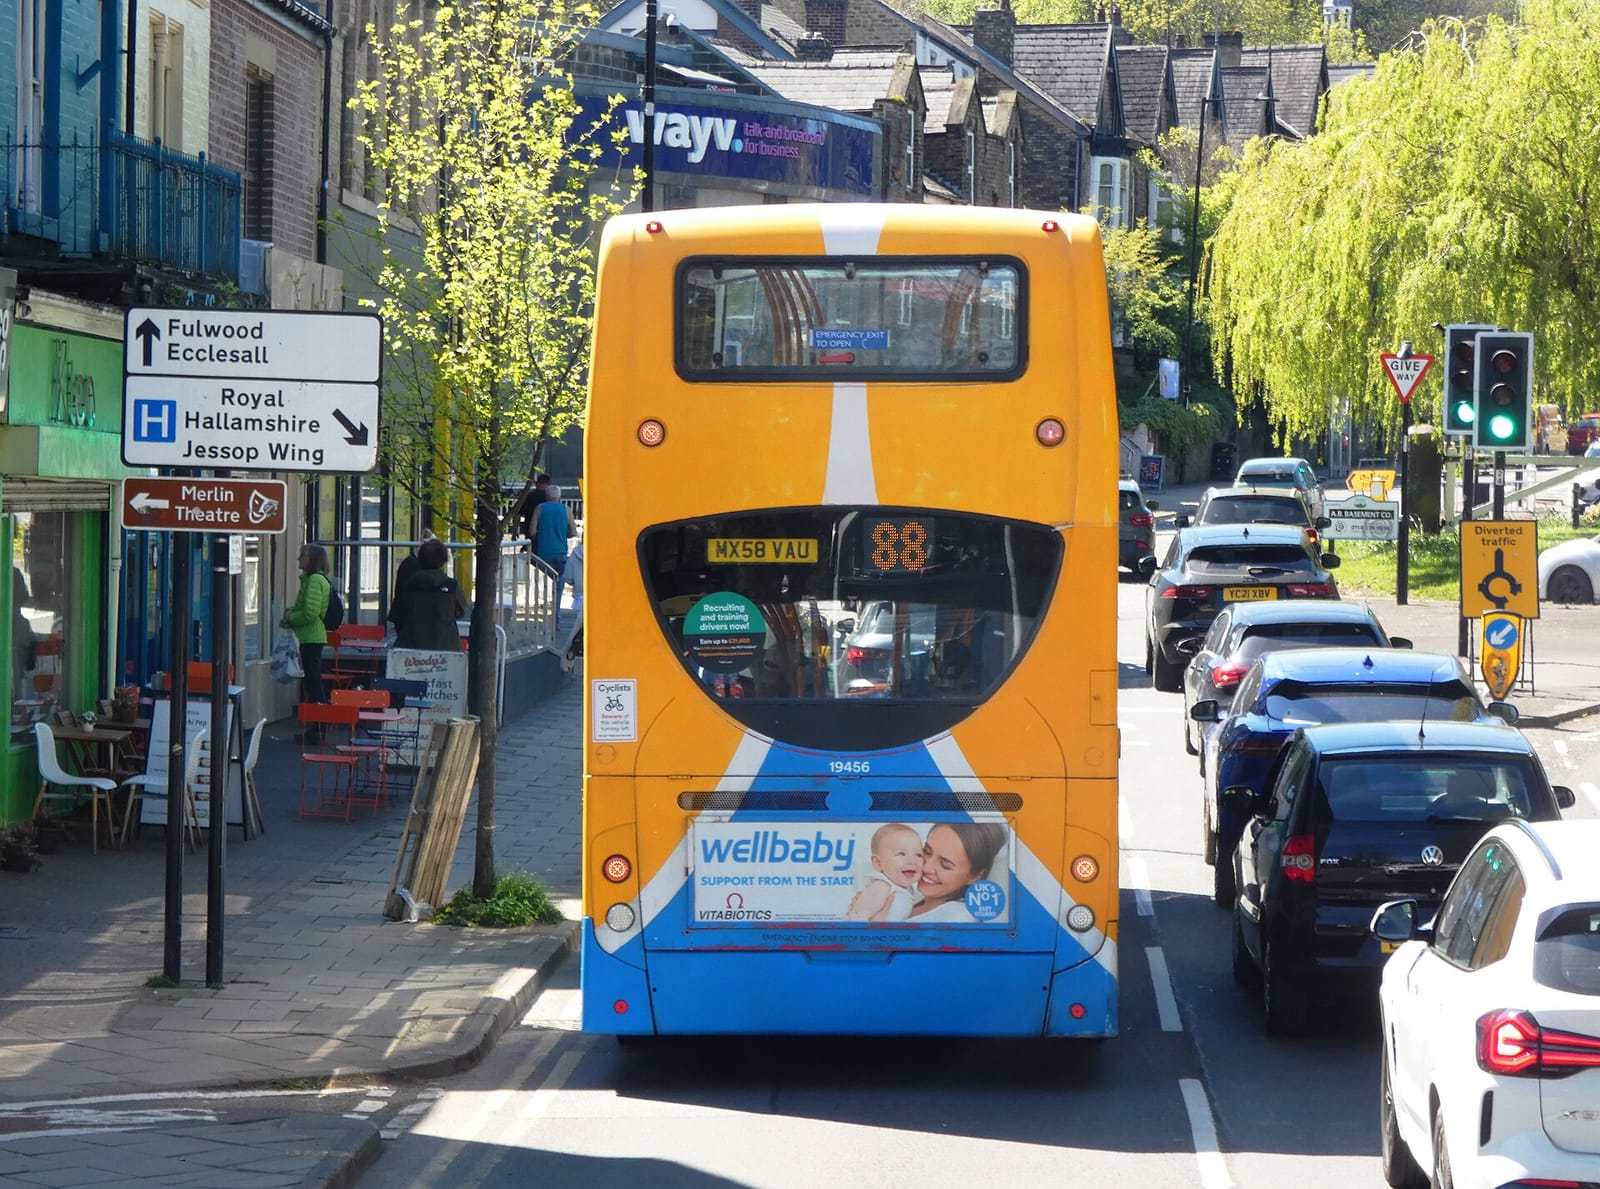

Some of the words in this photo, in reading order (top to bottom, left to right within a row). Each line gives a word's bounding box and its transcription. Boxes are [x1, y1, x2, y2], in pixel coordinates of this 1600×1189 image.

[744, 122, 762, 137] talk
[766, 125, 782, 139] and
[785, 128, 824, 145] broadband
[744, 138, 759, 154] for
[760, 141, 800, 159] business
[168, 319, 264, 340] Fulwood
[168, 343, 269, 364] Ecclesall
[1391, 361, 1420, 371] GIVE
[221, 388, 284, 410] Royal
[141, 404, 168, 438] H
[185, 412, 321, 433] Hallamshire
[182, 440, 258, 464] Jessop
[268, 444, 324, 465] Wing
[182, 486, 234, 503] Merlin
[175, 506, 240, 523] Theatre
[1475, 526, 1523, 535] Diverted
[715, 540, 766, 558] MX58
[773, 540, 809, 558] VAU
[870, 520, 927, 571] 88
[1482, 538, 1516, 546] traffic
[1229, 590, 1250, 599] YC21
[1252, 590, 1270, 598] XBV
[703, 603, 745, 612] Recruiting
[700, 613, 716, 621] and
[718, 613, 749, 622] training
[404, 655, 448, 668] Woody's
[598, 684, 631, 693] Cyclists
[829, 762, 870, 773] 19456
[701, 831, 855, 871] wellbaby
[701, 876, 755, 886] SUPPORT
[758, 876, 792, 886] FROM
[795, 876, 816, 886] THE
[820, 876, 855, 886] START
[975, 884, 996, 892] UK's
[699, 910, 772, 920] VITABIOTICS
